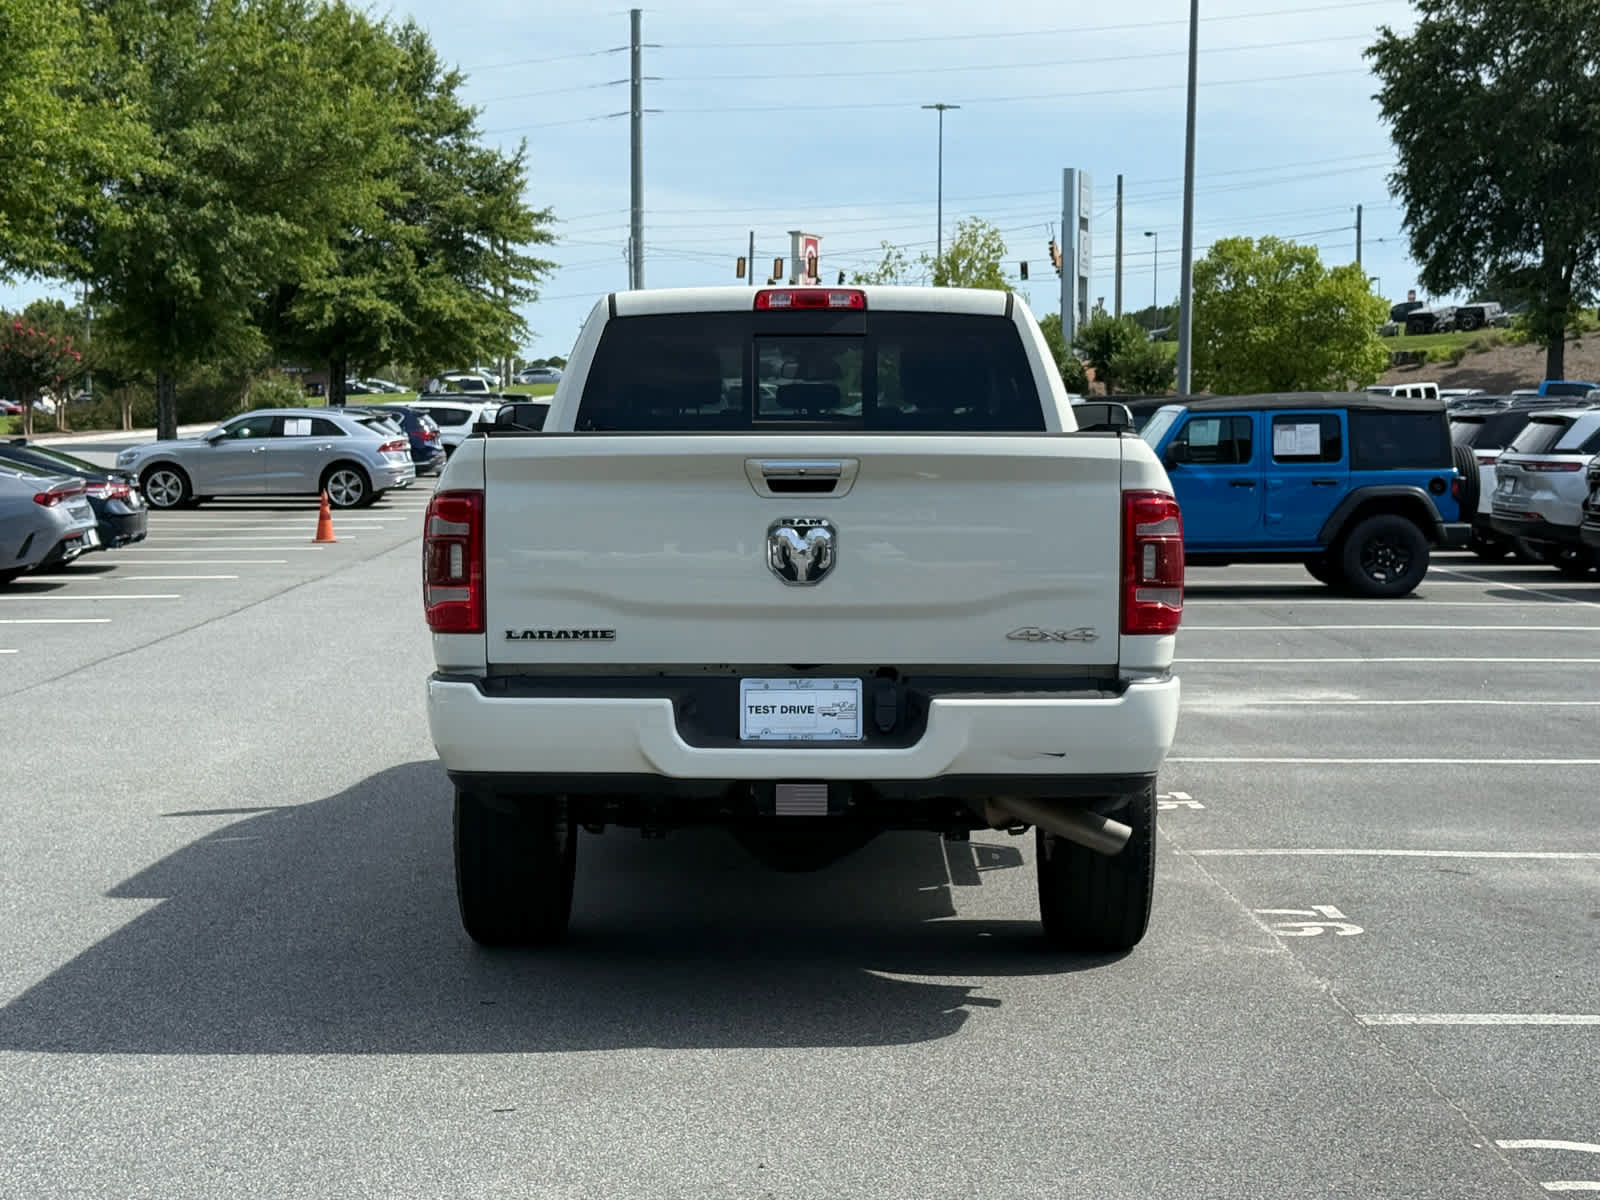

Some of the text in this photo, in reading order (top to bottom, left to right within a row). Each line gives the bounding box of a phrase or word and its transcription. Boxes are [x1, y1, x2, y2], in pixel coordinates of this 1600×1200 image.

[781, 518, 823, 527] RAM
[504, 630, 616, 641] LARAMIE
[748, 705, 815, 715] TEST DRIVE
